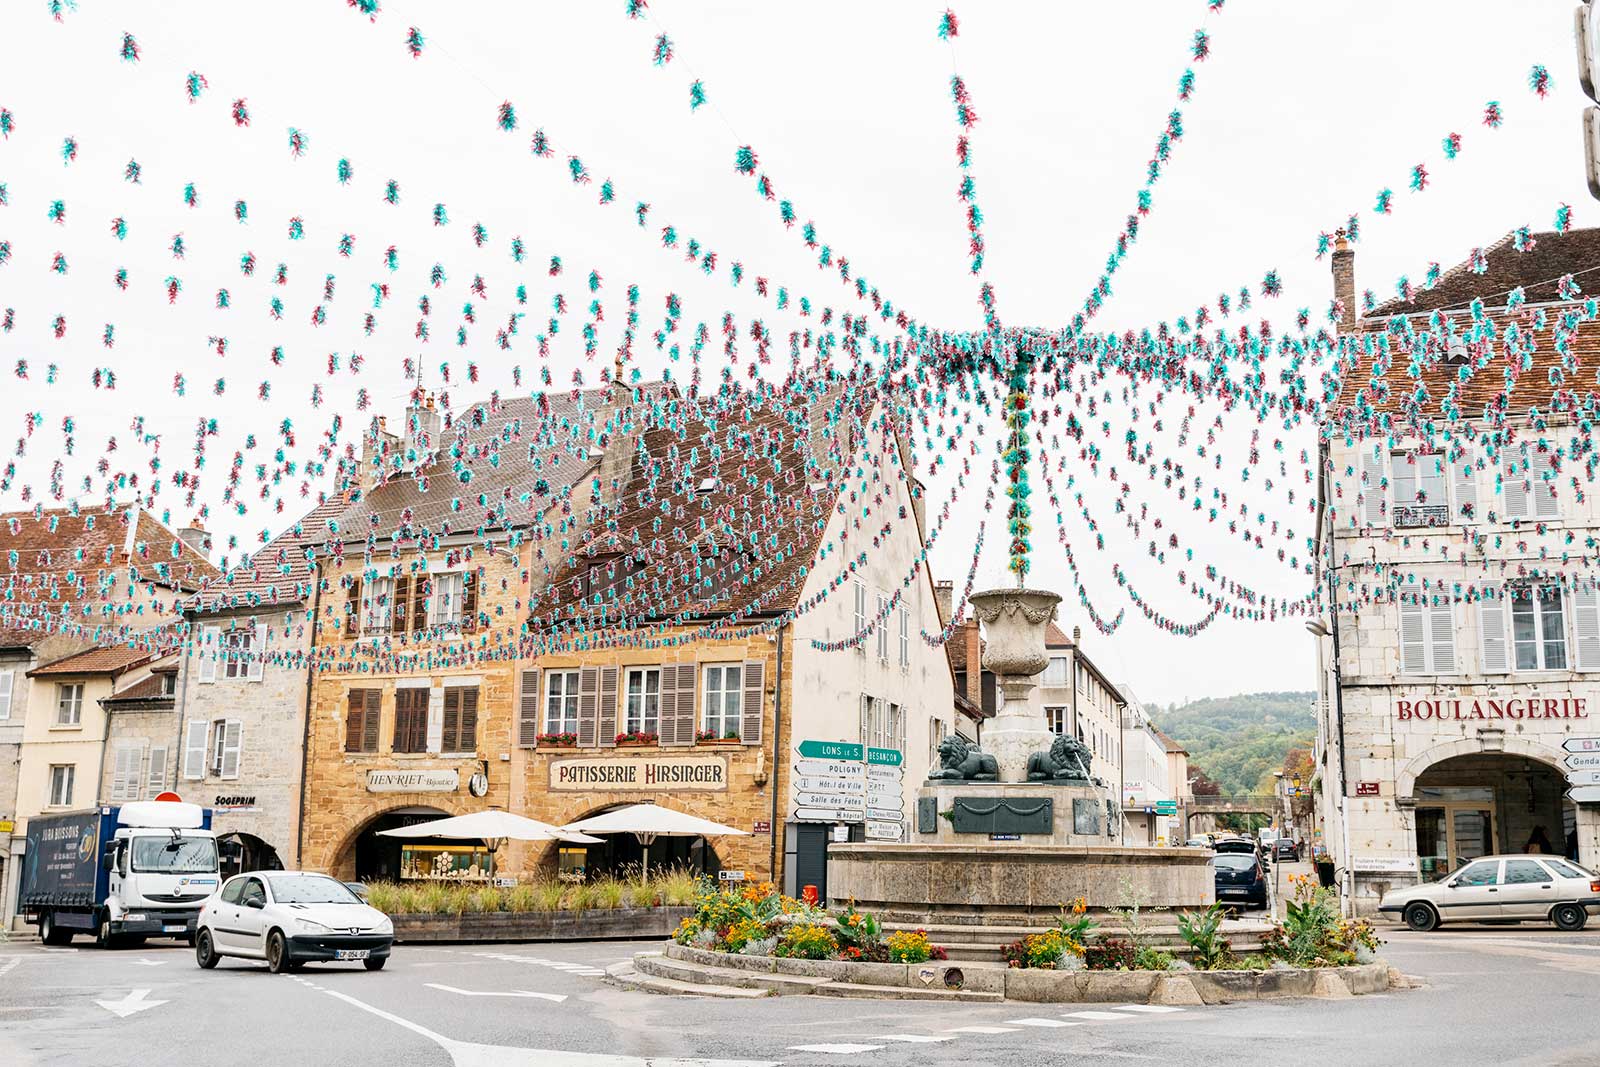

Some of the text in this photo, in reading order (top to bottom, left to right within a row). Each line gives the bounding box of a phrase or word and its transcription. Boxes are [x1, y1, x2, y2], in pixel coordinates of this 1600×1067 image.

[1397, 698, 1589, 721] BOULANGERIE
[822, 745, 842, 755] LONS
[868, 751, 897, 762] BESANÇON
[559, 763, 723, 785] PATISSERIE HIRSINGER
[829, 765, 861, 773] POLIGNY
[214, 795, 256, 806] SOGEPRIM
[810, 795, 827, 804] Salle
[830, 797, 841, 805] des
[42, 828, 54, 841] JURA
